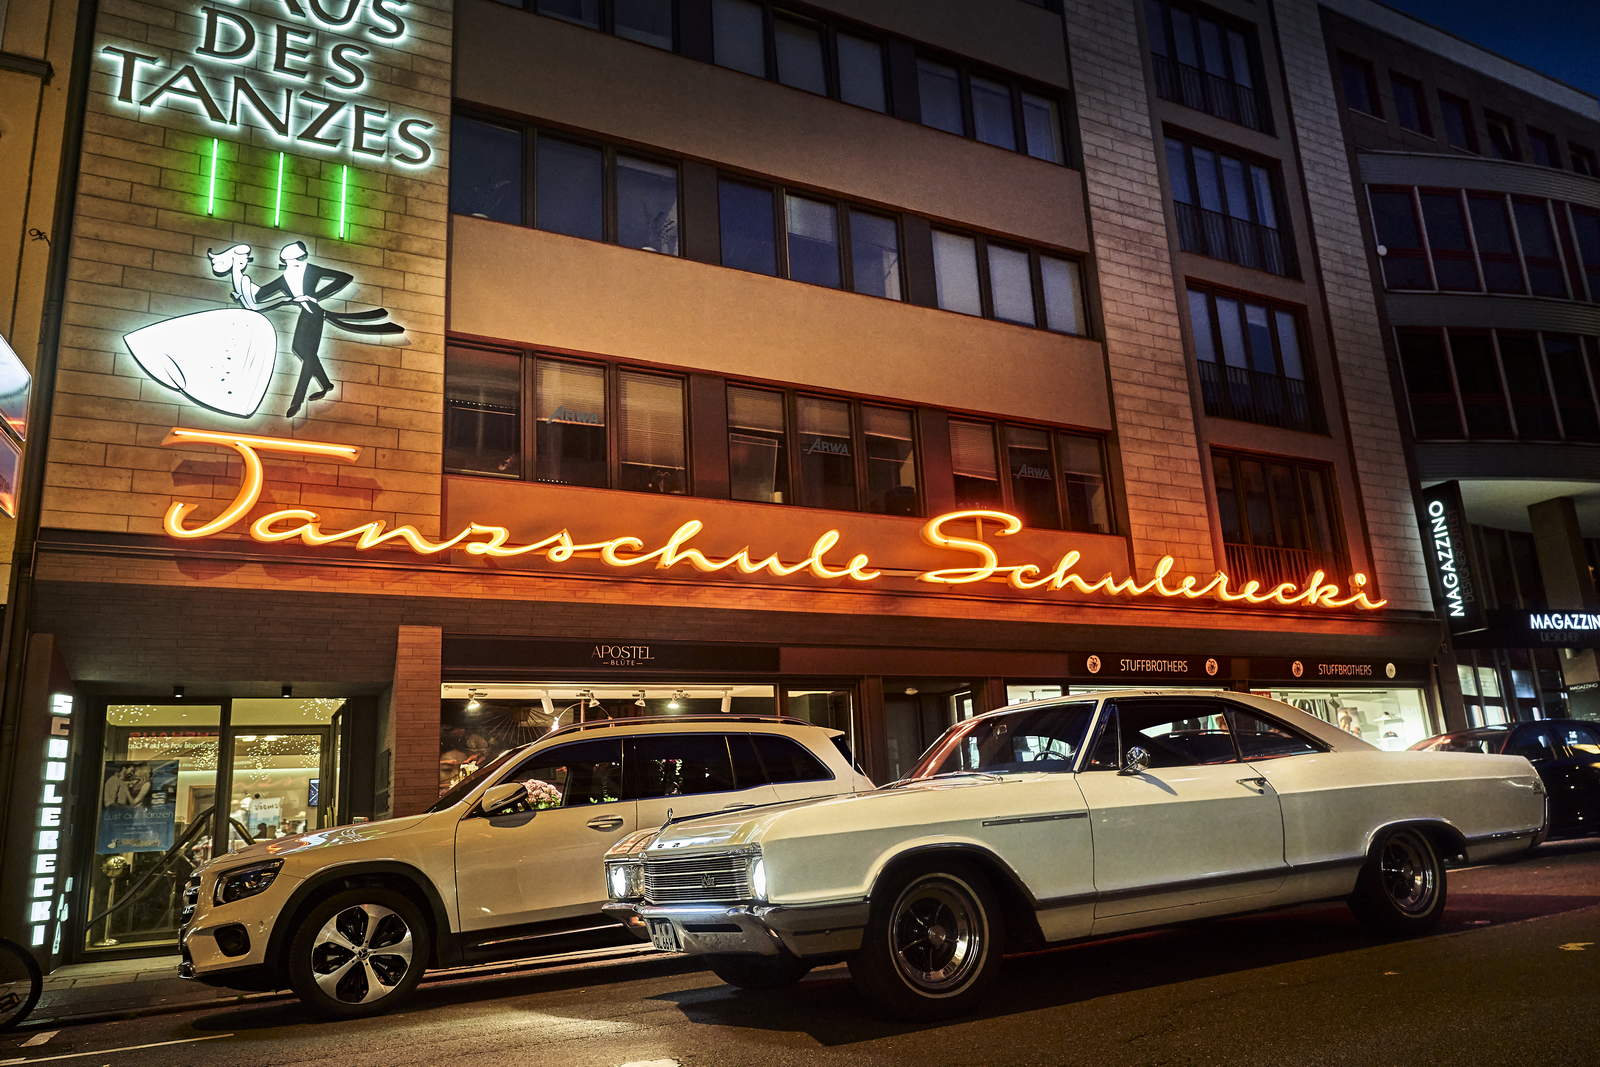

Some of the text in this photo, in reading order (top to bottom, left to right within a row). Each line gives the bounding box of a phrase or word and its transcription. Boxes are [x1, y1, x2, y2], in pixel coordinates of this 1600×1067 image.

[196, 6, 370, 90] DES
[101, 45, 435, 166] TANZES
[161, 427, 1387, 611] Tanzschule Schulerecki
[1428, 500, 1465, 617] MAGAZZINO
[591, 645, 655, 660] APOSTEL
[1120, 658, 1188, 673] STUFFBROTHERS
[1318, 663, 1372, 676] STUFFBROTHERS
